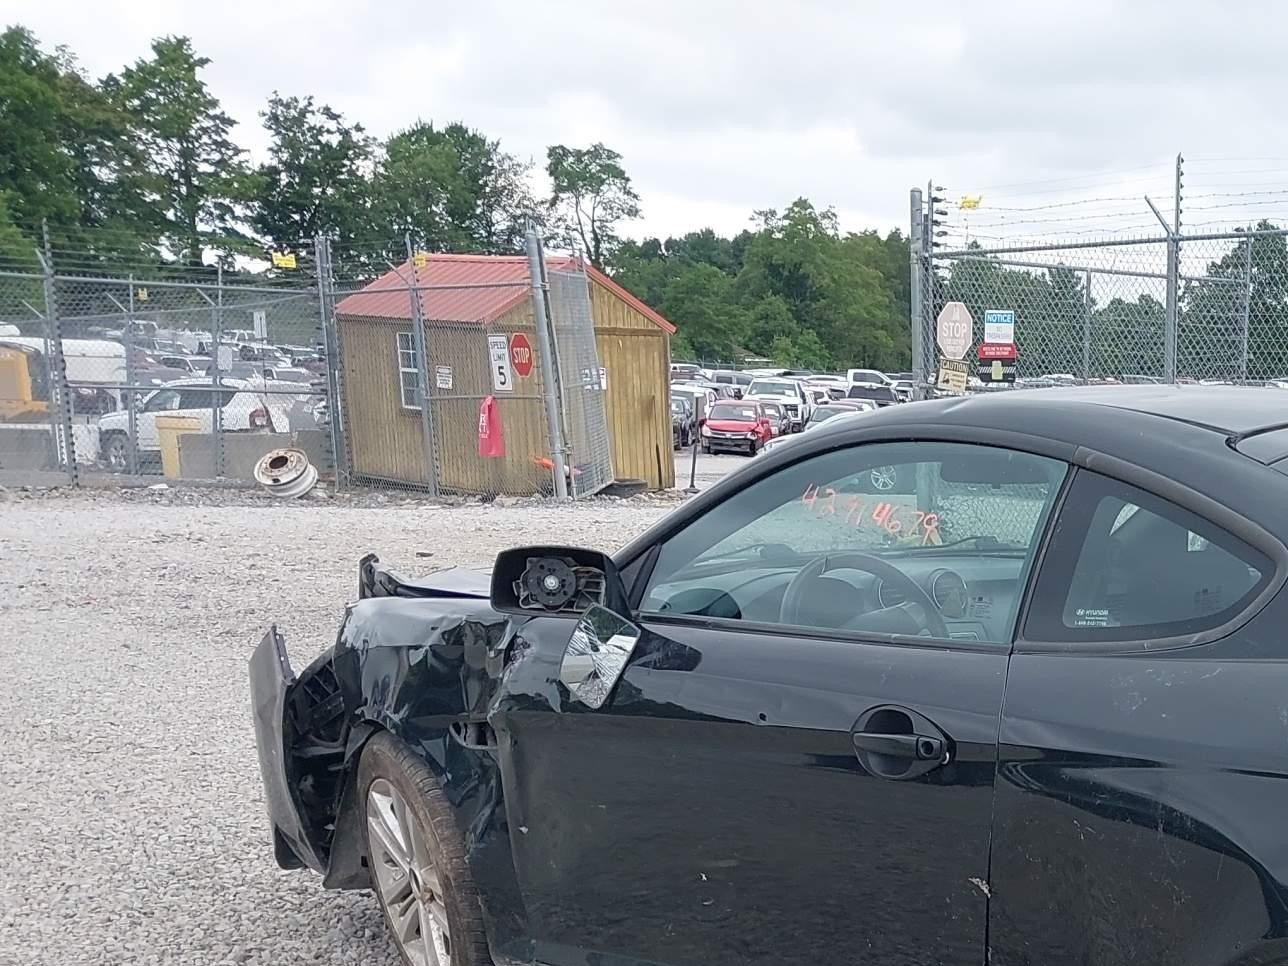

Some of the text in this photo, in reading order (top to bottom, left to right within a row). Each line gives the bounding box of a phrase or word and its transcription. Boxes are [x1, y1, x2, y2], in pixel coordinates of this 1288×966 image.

[987, 314, 1011, 322] NOTICE
[942, 322, 967, 337] STOP
[490, 341, 506, 349] SPEED
[513, 347, 530, 363] STOP
[942, 360, 968, 373] CAUTION
[497, 365, 507, 385] 5
